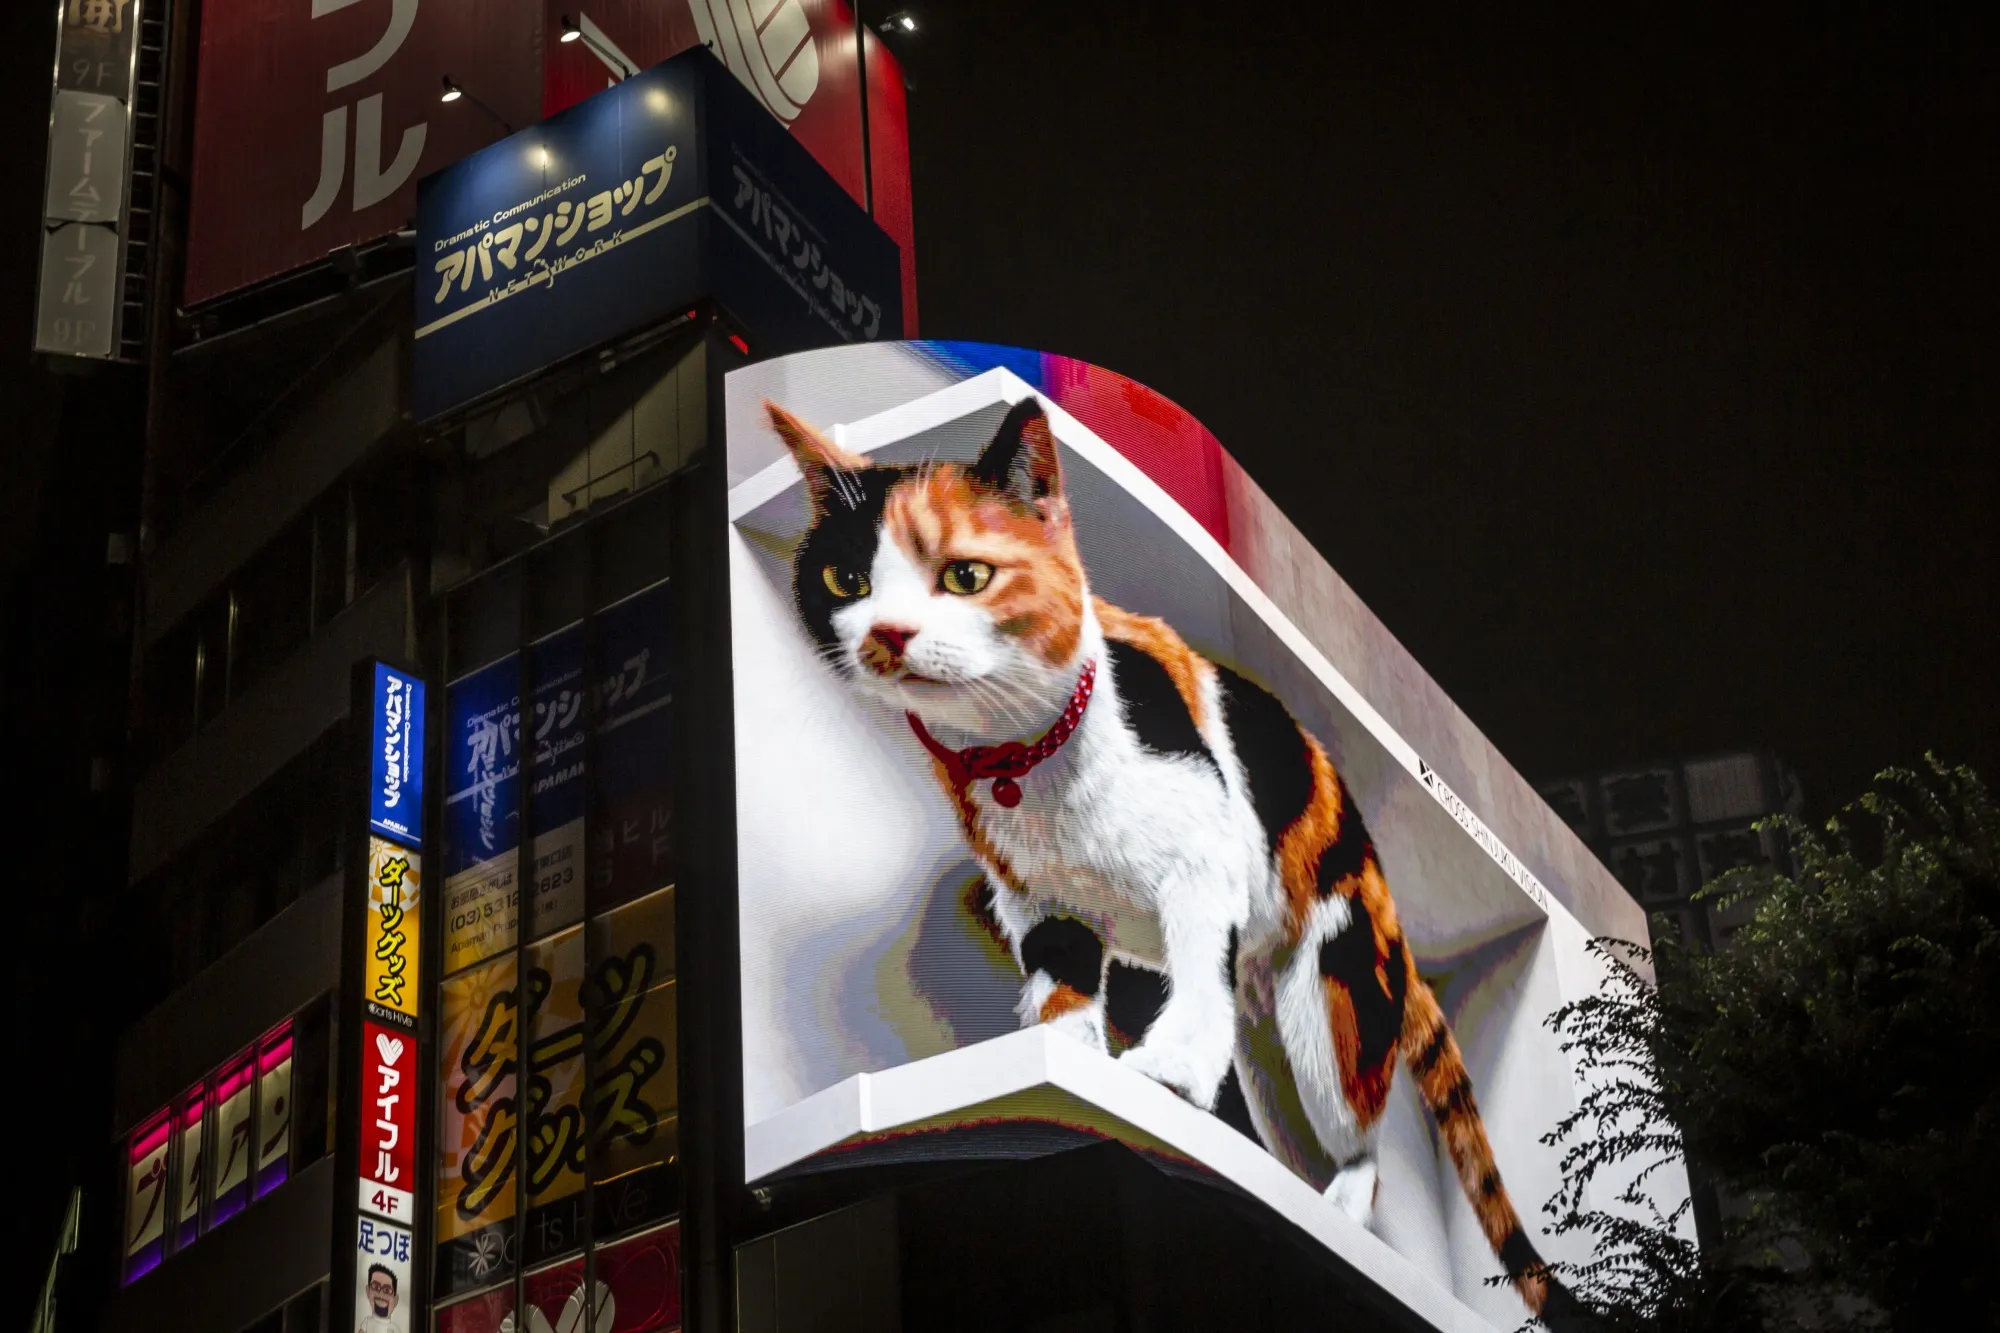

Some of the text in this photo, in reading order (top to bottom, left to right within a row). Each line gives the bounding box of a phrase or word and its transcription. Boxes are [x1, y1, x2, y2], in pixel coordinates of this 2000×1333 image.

[434, 174, 586, 253] Dramatic Communication
[434, 144, 677, 304] アパマンショップ
[732, 164, 881, 340] アパマンショップ
[384, 675, 403, 808] アパマンショップ
[1437, 782, 1469, 828] CROSS
[375, 857, 411, 1007] ダーツグッズ
[374, 1064, 400, 1183] アイフル
[358, 1219, 410, 1262] 足つぼ
[371, 1190, 398, 1214] 4F
